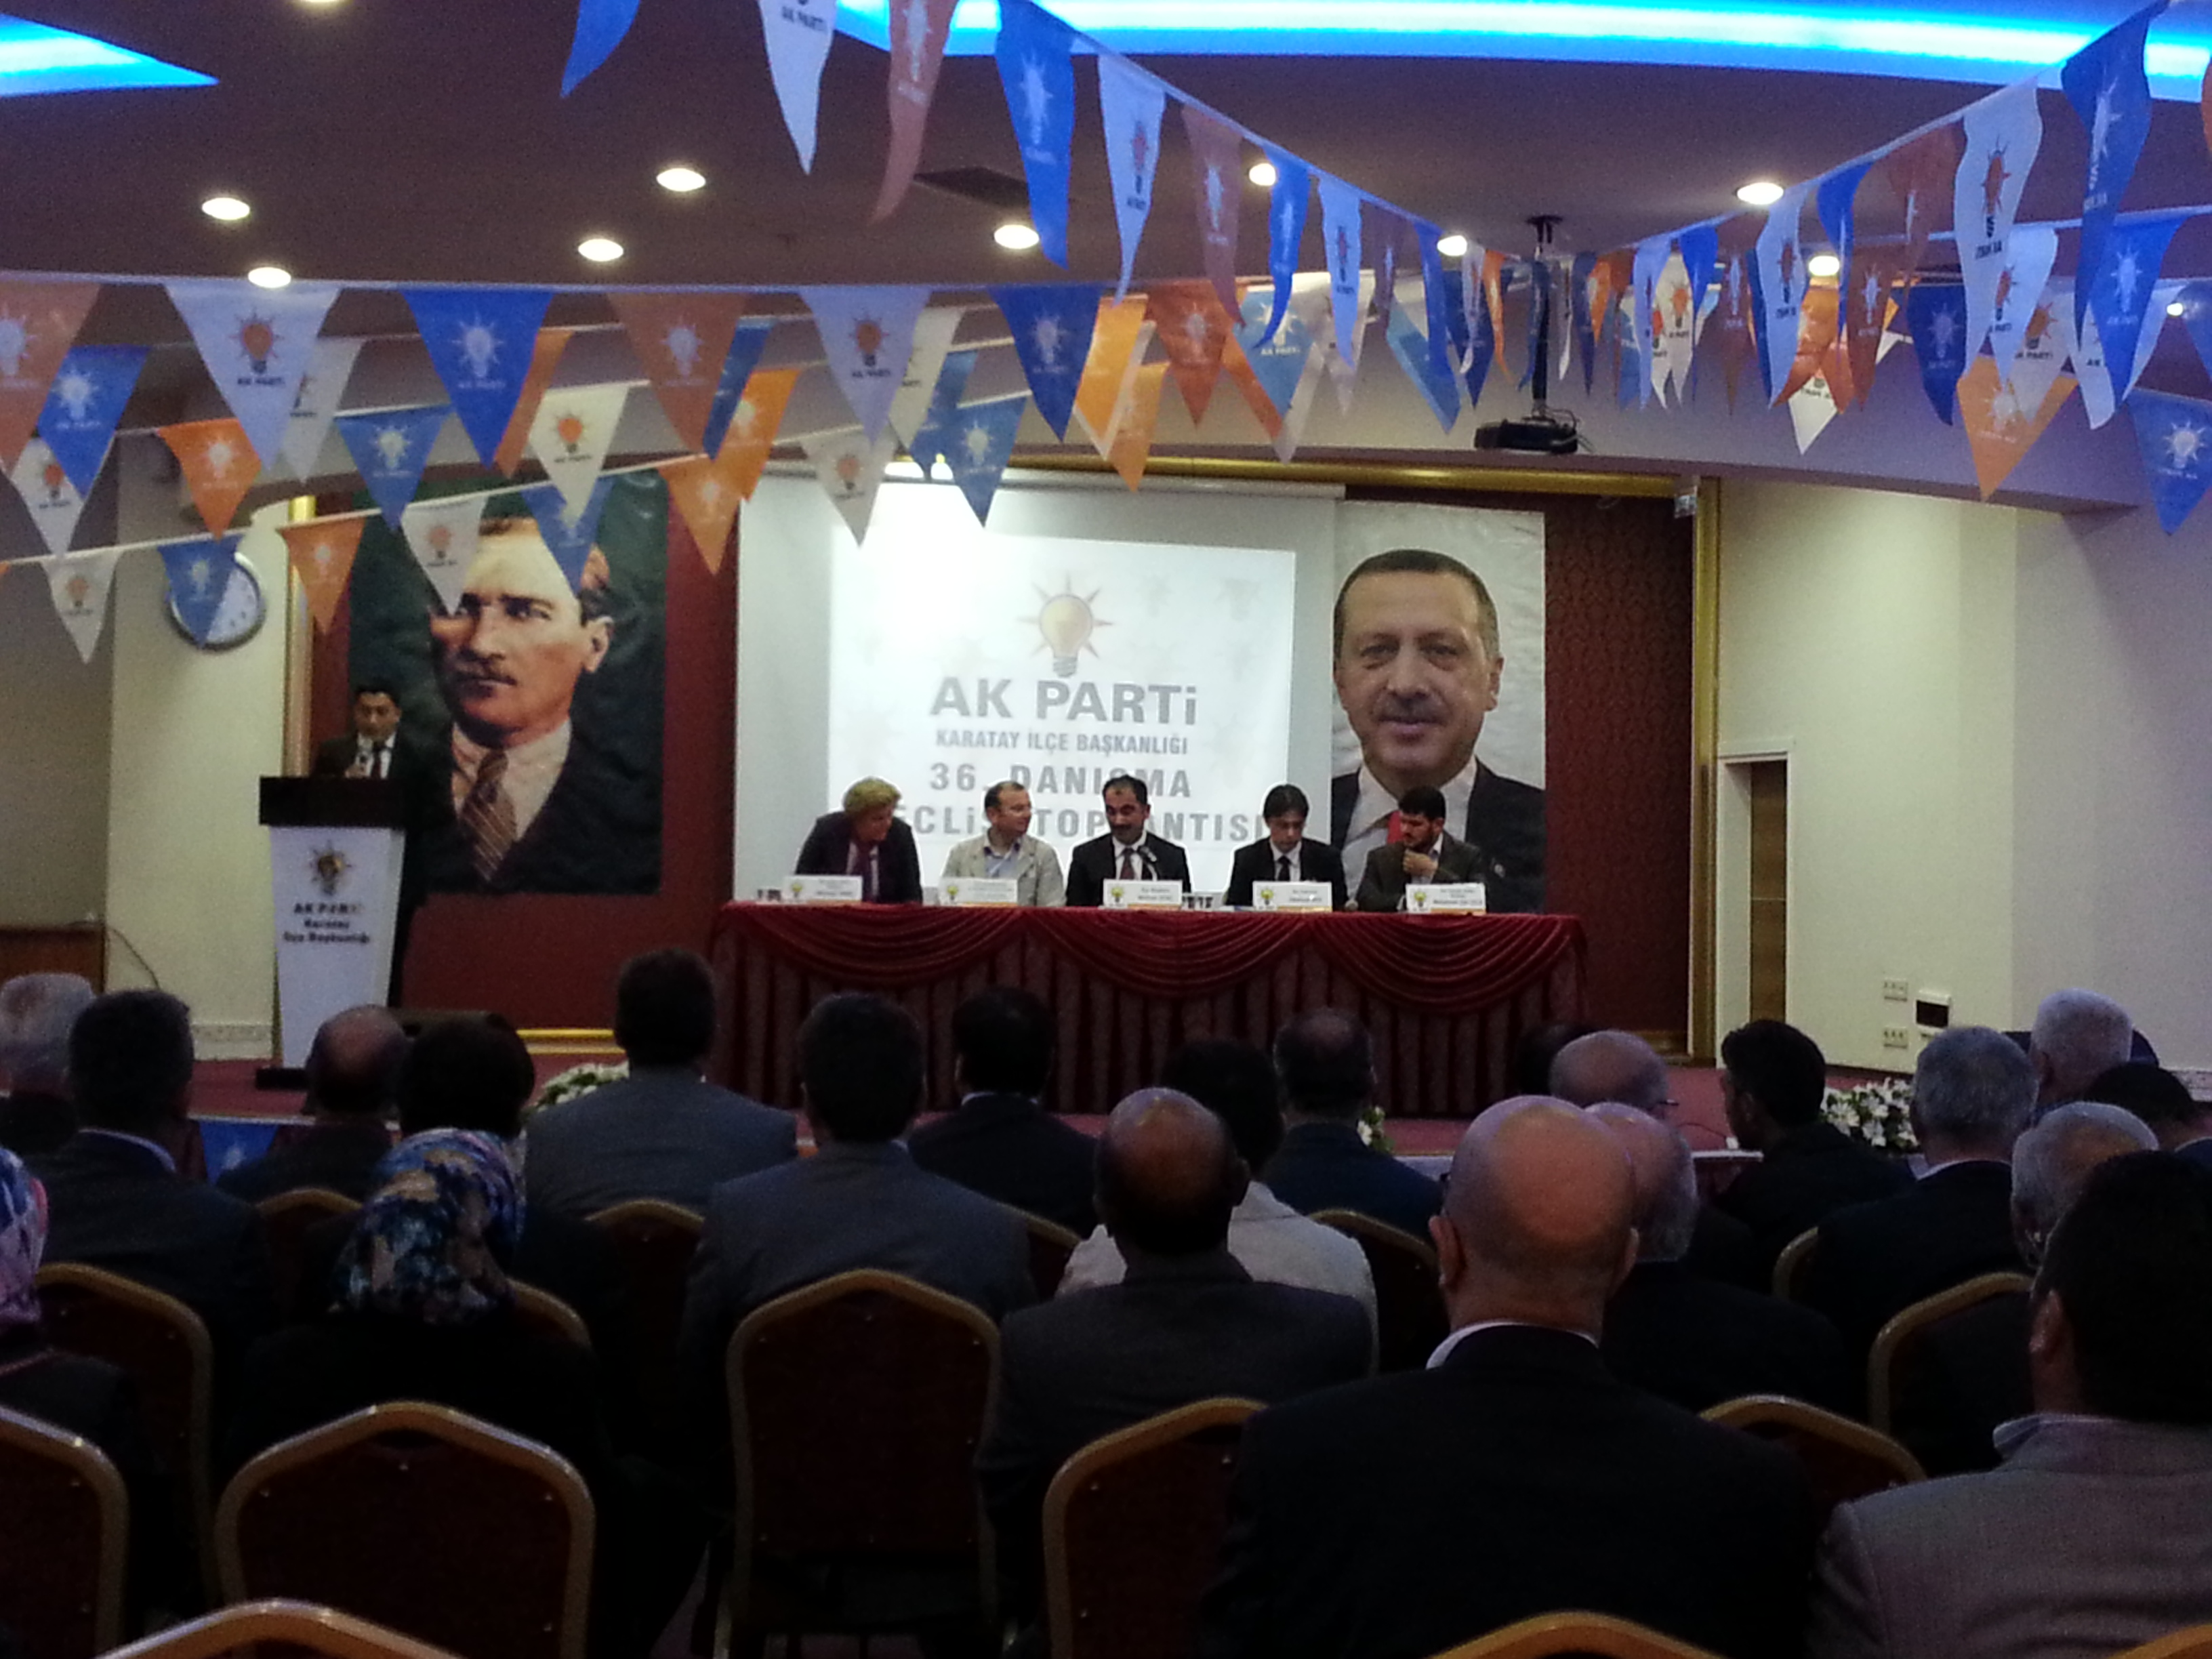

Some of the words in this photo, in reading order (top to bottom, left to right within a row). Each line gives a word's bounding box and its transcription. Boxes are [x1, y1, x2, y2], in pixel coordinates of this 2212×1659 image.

[930, 677, 1013, 718] AK
[936, 729, 1019, 749] KARATAY
[1028, 728, 1069, 754] İLÇE
[1076, 732, 1188, 756] BAŞKANLIĞI
[1010, 765, 1191, 798] DANIMA
[1035, 808, 1263, 841] TOPNTISI
